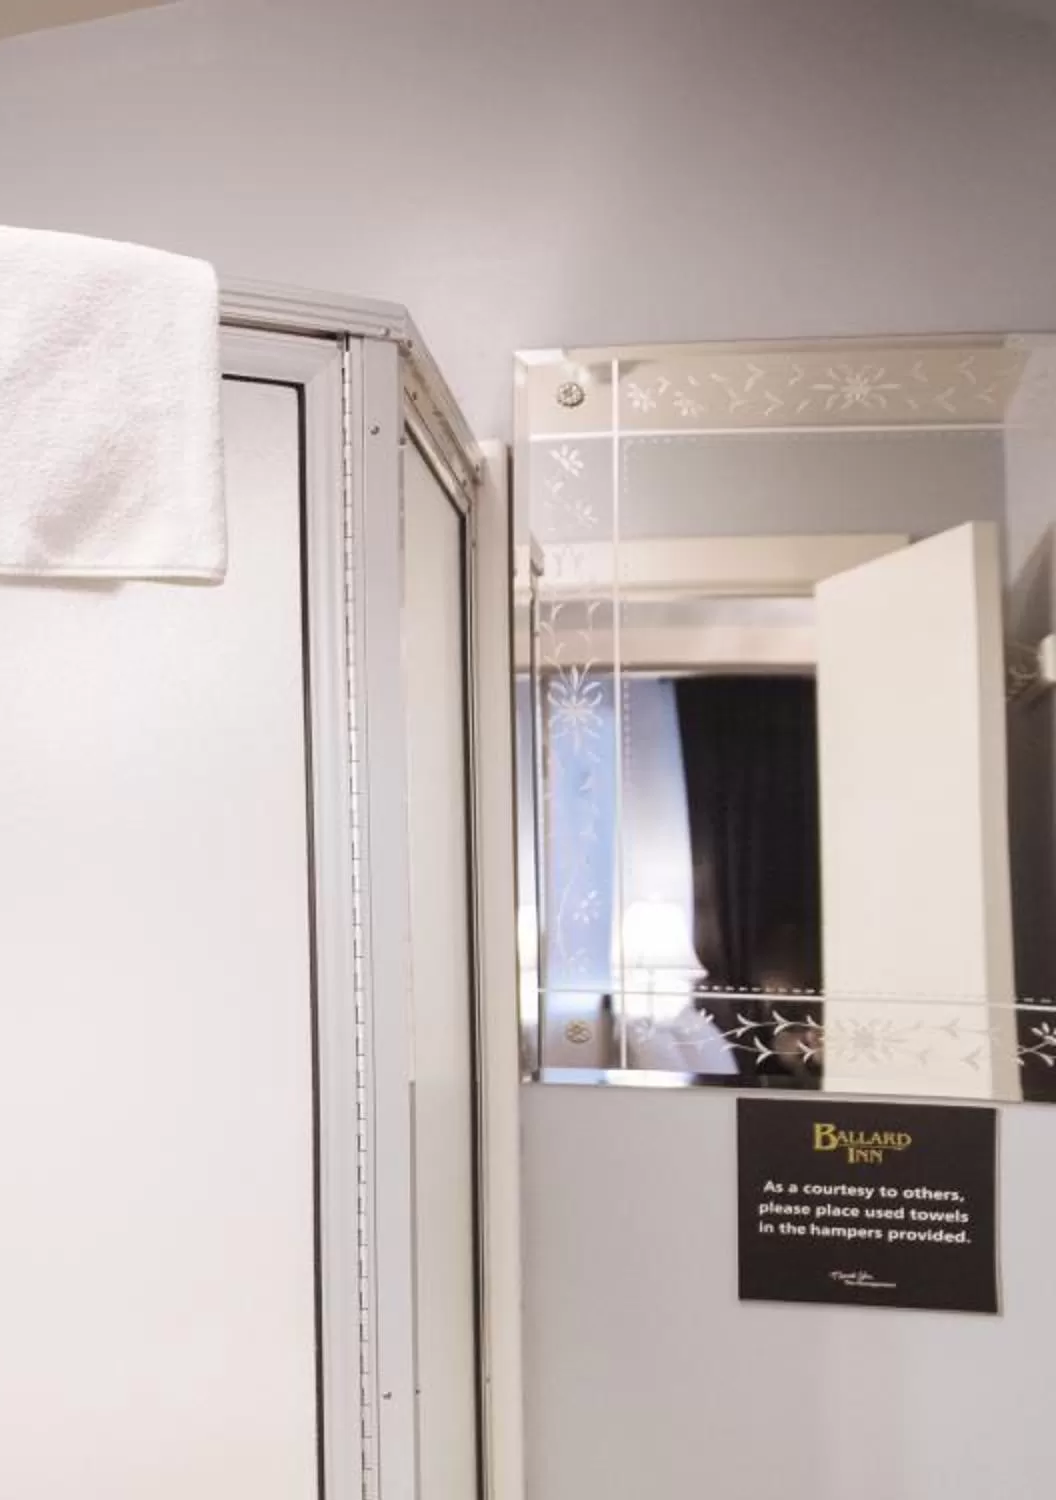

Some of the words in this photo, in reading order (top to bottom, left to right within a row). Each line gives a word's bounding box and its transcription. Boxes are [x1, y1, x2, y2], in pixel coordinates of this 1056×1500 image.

[812, 1122, 912, 1151] BALLARD
[847, 1147, 883, 1163] INN
[763, 1181, 783, 1193] As
[788, 1183, 799, 1194] a
[803, 1183, 874, 1199] courtesy
[880, 1186, 897, 1197] to
[903, 1186, 965, 1202] others,
[759, 1202, 811, 1216] please
[816, 1203, 860, 1218] place
[865, 1206, 905, 1220] used
[910, 1209, 969, 1223] towels
[759, 1221, 774, 1233] in
[780, 1222, 806, 1235] the
[811, 1223, 883, 1240] hampers
[888, 1229, 971, 1244] provided.
